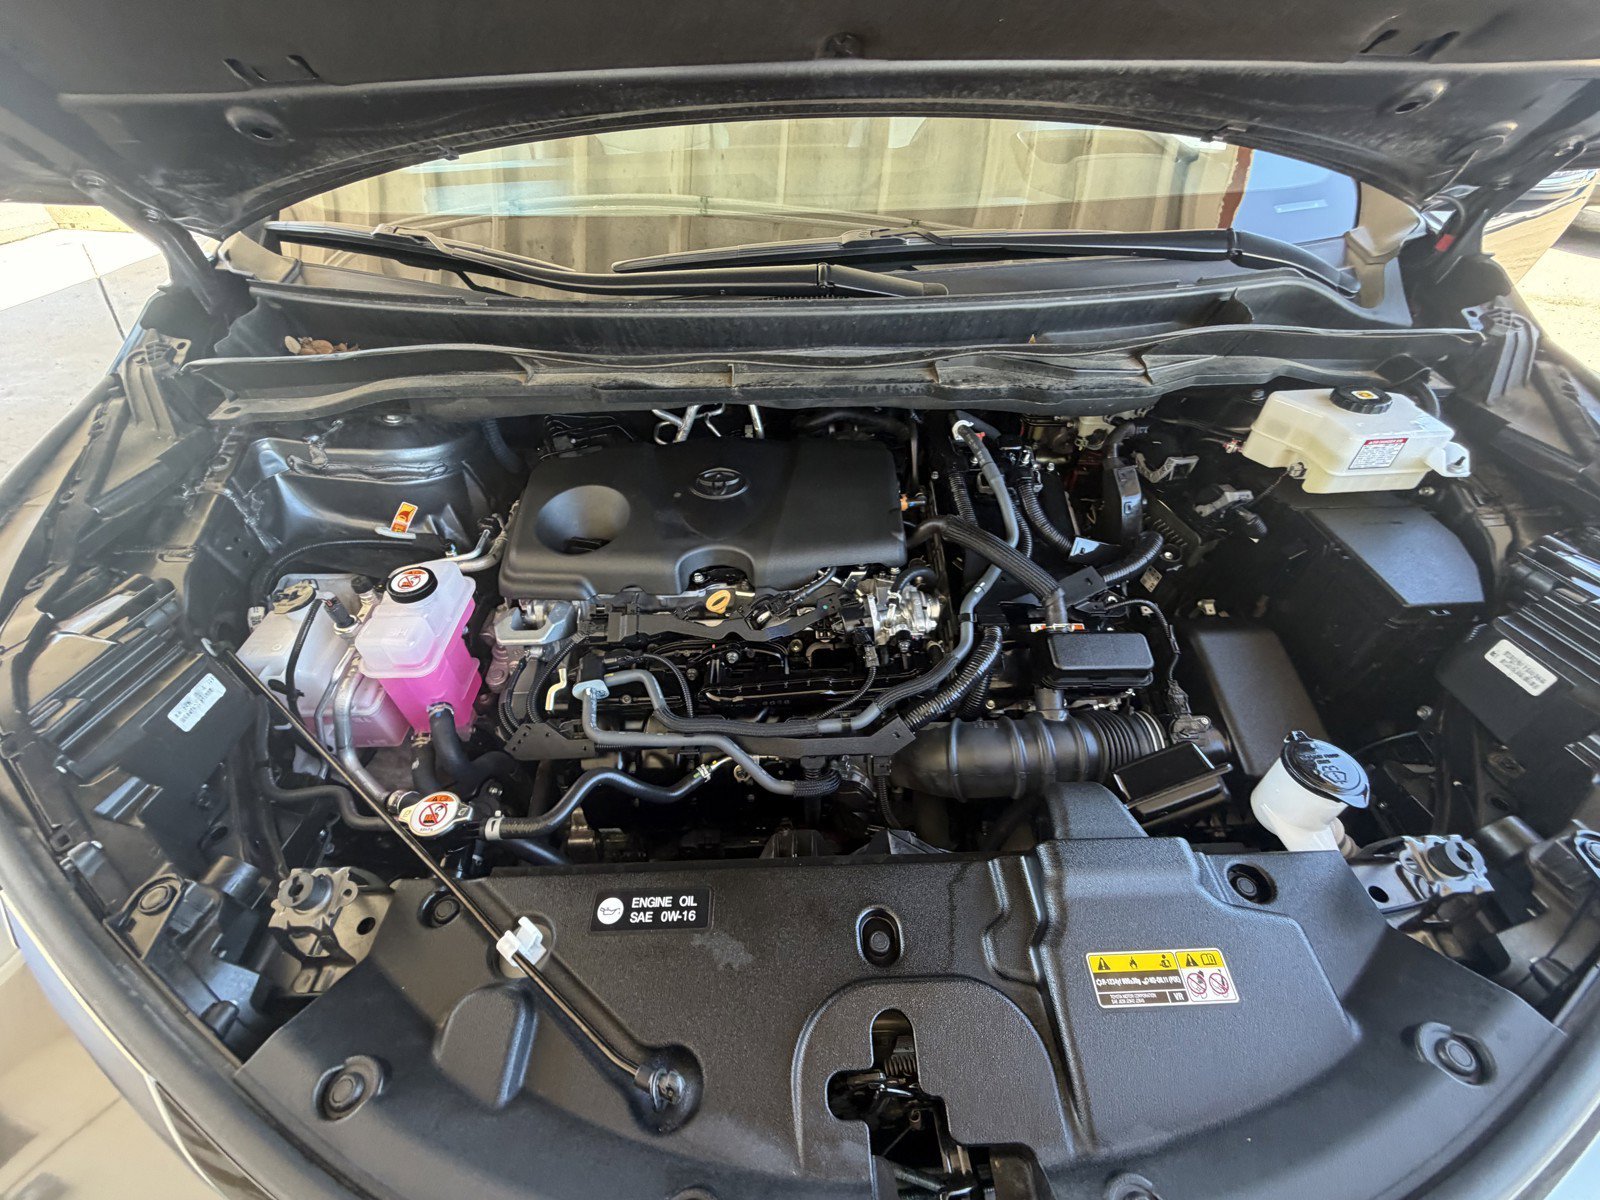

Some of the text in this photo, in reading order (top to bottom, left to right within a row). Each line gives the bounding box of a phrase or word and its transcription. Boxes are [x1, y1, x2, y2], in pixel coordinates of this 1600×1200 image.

[631, 895, 698, 908] ENGINE OIL
[629, 910, 696, 923] SAE 0W-16
[1173, 992, 1185, 1001] VR
